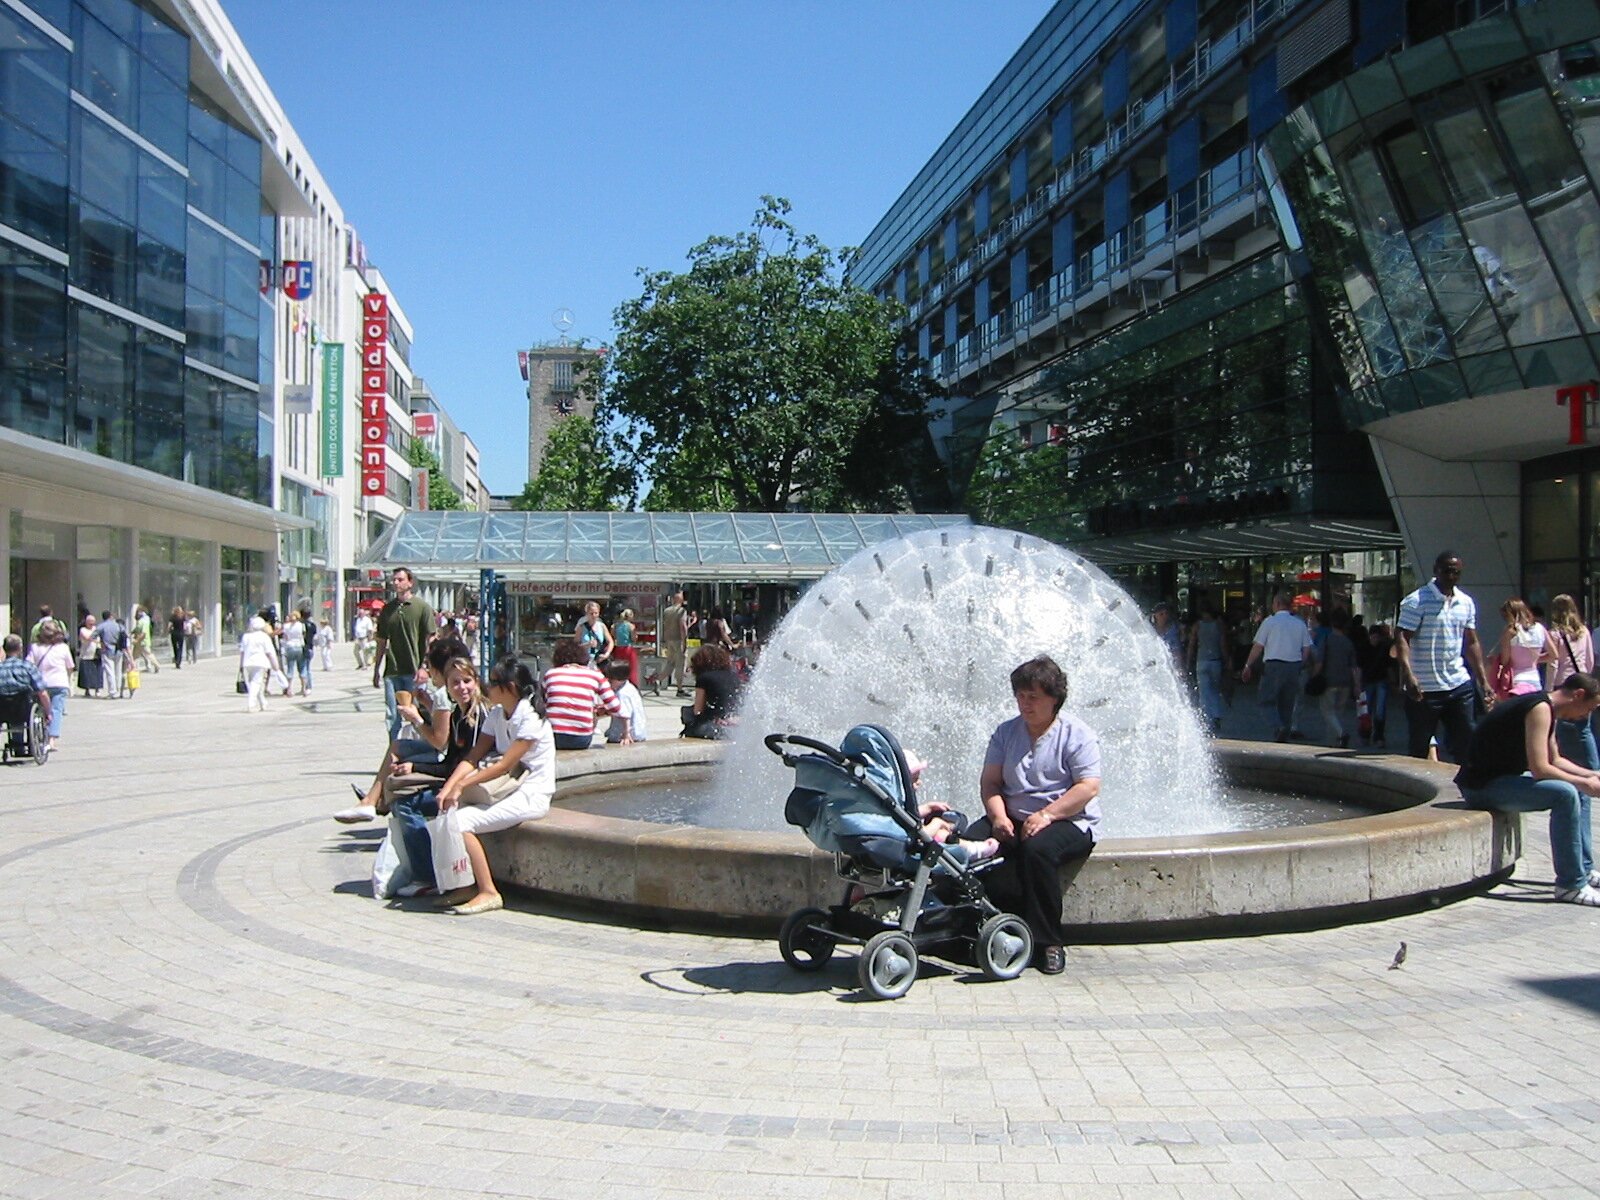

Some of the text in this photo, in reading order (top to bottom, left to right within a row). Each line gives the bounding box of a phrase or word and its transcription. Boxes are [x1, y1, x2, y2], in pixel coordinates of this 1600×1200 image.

[329, 394, 338, 405] OF
[367, 298, 383, 491] vodafone
[329, 408, 338, 441] COLORS
[329, 443, 338, 474] UNITED
[585, 582, 601, 593] Ihr
